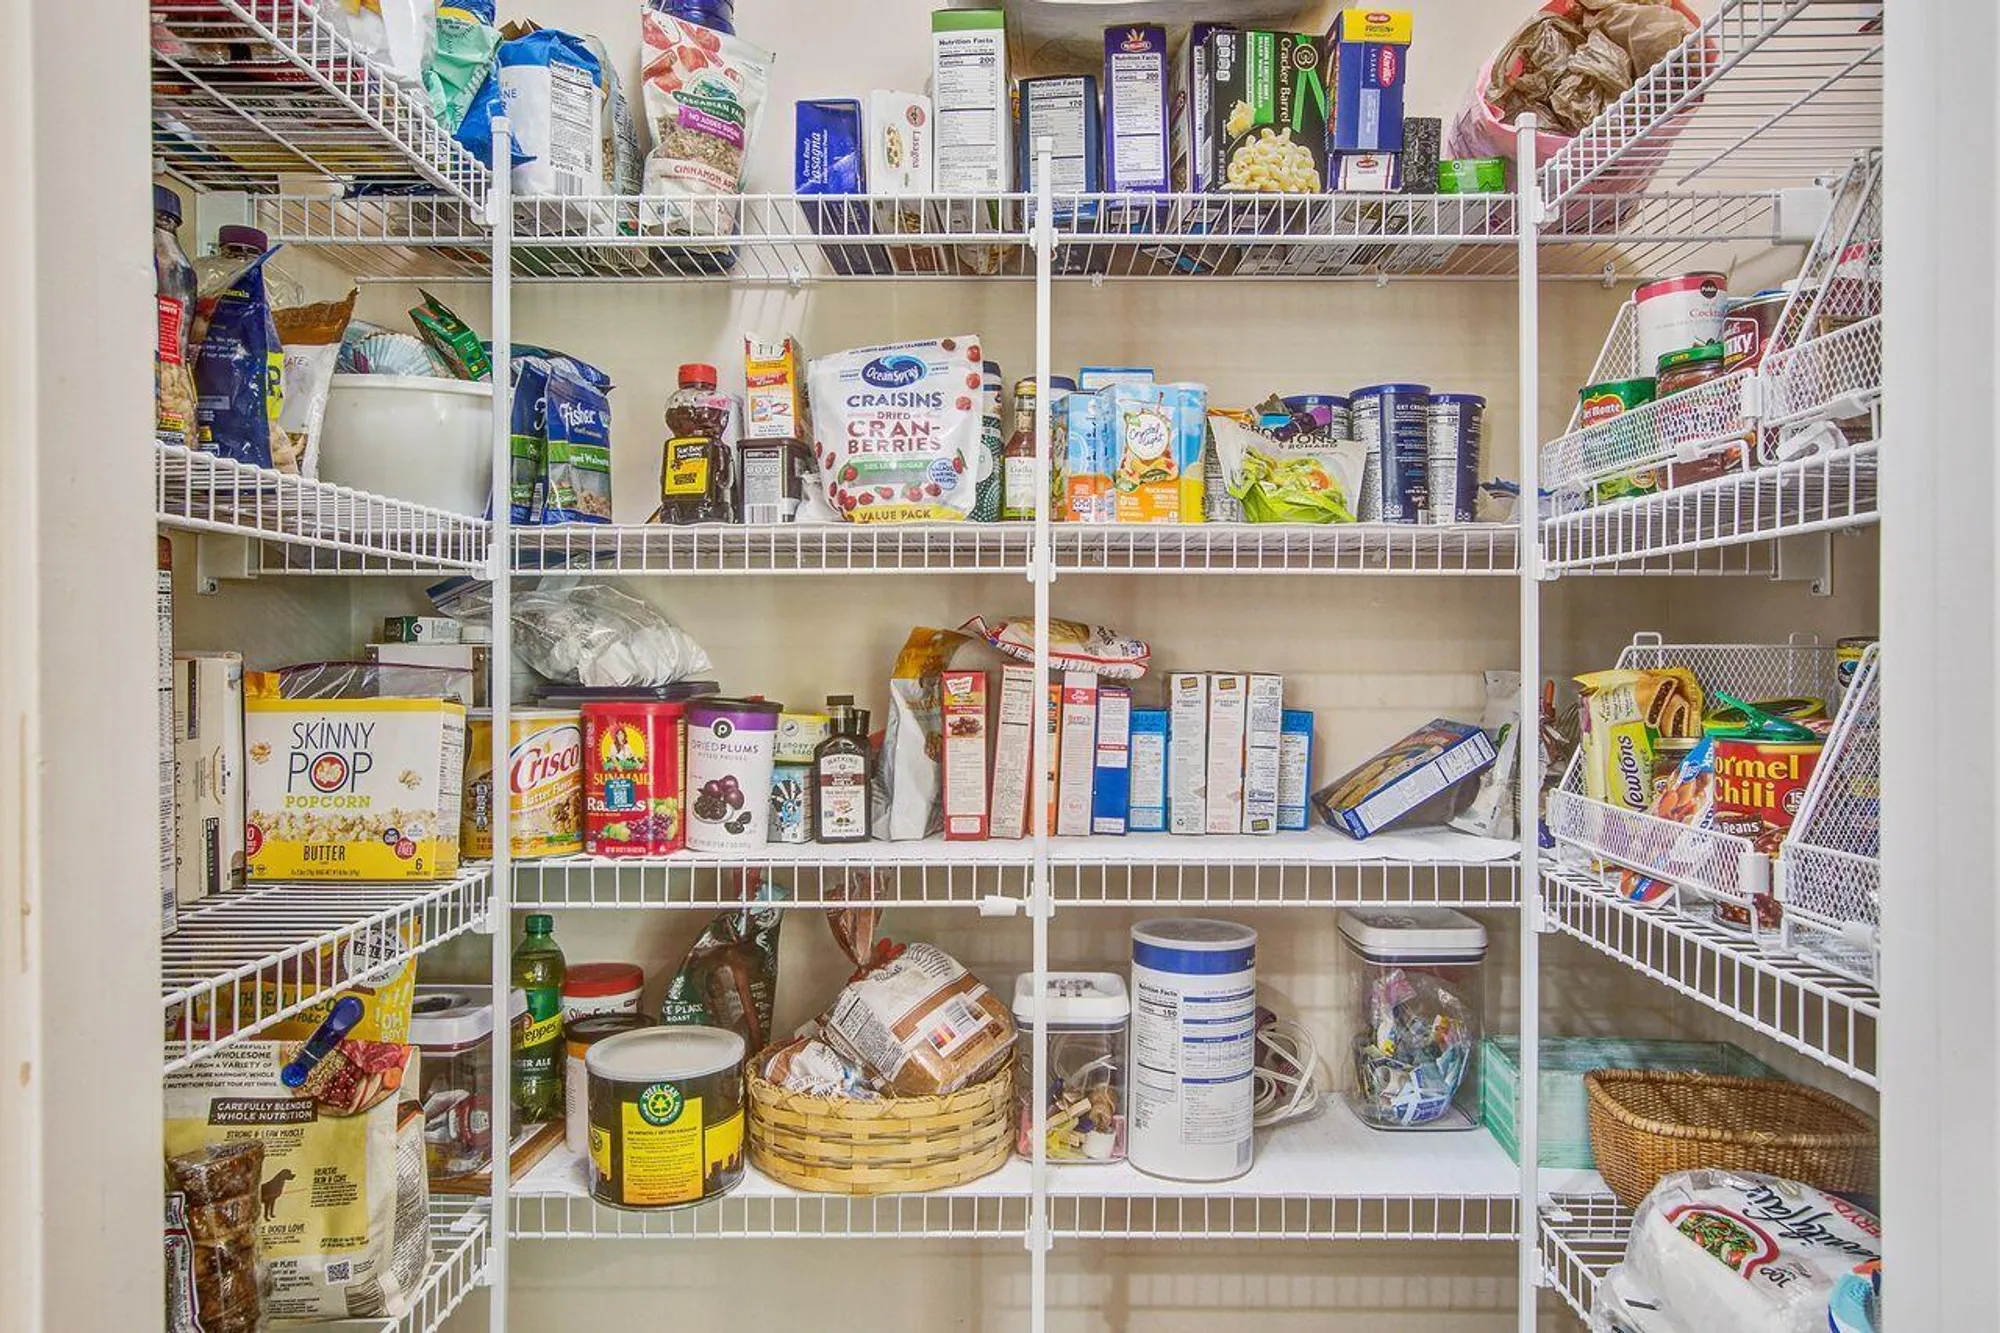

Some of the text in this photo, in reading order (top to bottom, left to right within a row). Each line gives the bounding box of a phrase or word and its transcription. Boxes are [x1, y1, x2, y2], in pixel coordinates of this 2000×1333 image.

[1280, 37, 1292, 124] Cracker Barrel
[809, 132, 824, 184] Lasagna
[910, 131, 922, 169] Lasagna
[673, 165, 722, 184] CINNAMON
[804, 160, 812, 176] Oven
[846, 392, 942, 408] CRAISINS
[560, 402, 597, 433] Fisher
[877, 411, 911, 420] DRIED
[847, 420, 941, 438] CRAN-
[847, 437, 941, 454] BERRIES
[860, 509, 931, 521] VALUE PACK
[287, 751, 373, 794] POP
[510, 743, 579, 794] Crisco
[1715, 754, 1799, 780] ormel
[1714, 776, 1776, 808] Chili
[285, 795, 372, 809] POPCORN
[1720, 821, 1761, 835] Beans
[303, 844, 346, 862] BUTTER
[415, 858, 423, 869] 6
[1162, 1009, 1178, 1017] 150
[213, 1051, 272, 1060] WHOLESOME
[535, 1057, 551, 1066] ALE
[222, 1061, 261, 1069] VARIETY
[249, 1071, 275, 1079] WHOLE
[217, 1101, 312, 1111] CAREFULLY BLENDED
[217, 1110, 312, 1120] WHOLE NUTRITION
[226, 1130, 252, 1139] STRONG
